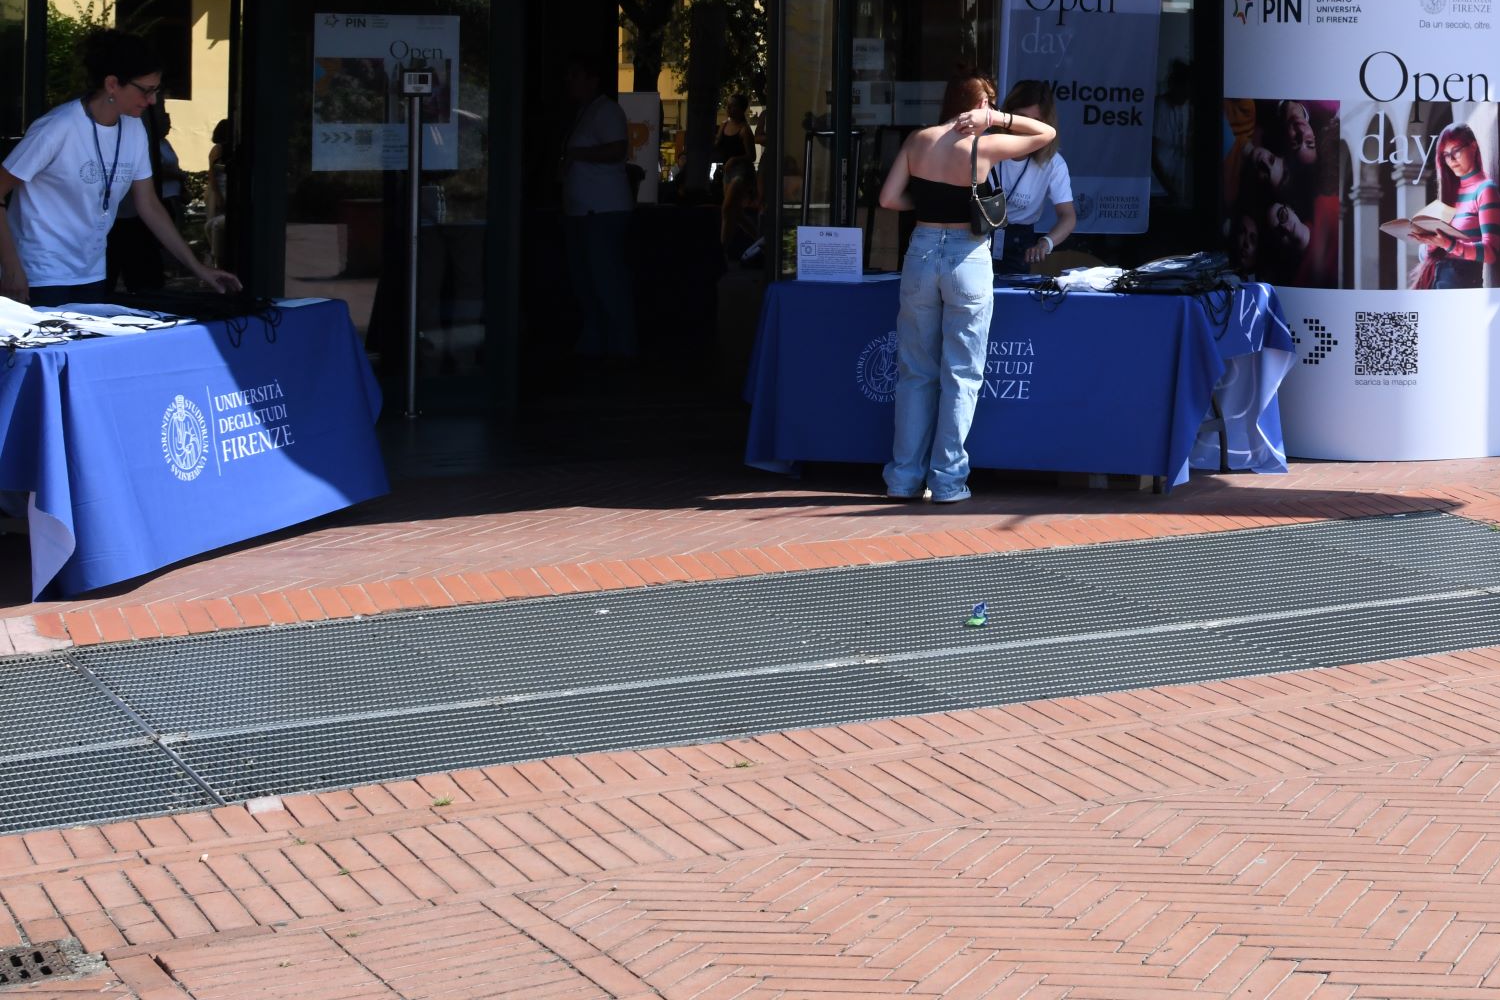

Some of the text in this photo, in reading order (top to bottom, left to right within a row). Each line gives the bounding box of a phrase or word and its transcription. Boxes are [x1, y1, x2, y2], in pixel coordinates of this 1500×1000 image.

[1316, 5, 1362, 13] UNIVERSITÀ
[1452, 4, 1492, 13] FIRENZE
[345, 18, 366, 28] PIN
[1419, 20, 1431, 28] Da
[1021, 16, 1073, 68] day
[390, 39, 443, 67] Open
[1359, 51, 1491, 123] Open
[1083, 105, 1143, 126] Desk
[1360, 111, 1440, 185] day
[1098, 210, 1140, 219] FIRENZE
[988, 338, 1035, 356] RSITÀ
[984, 360, 1034, 375] STUDI
[980, 379, 1032, 400] NZE
[1391, 379, 1417, 388] mappa
[214, 379, 284, 412] UNIVERSITÀ
[218, 403, 288, 434] DEGLI STUDI
[221, 424, 295, 463] FIRENZE
